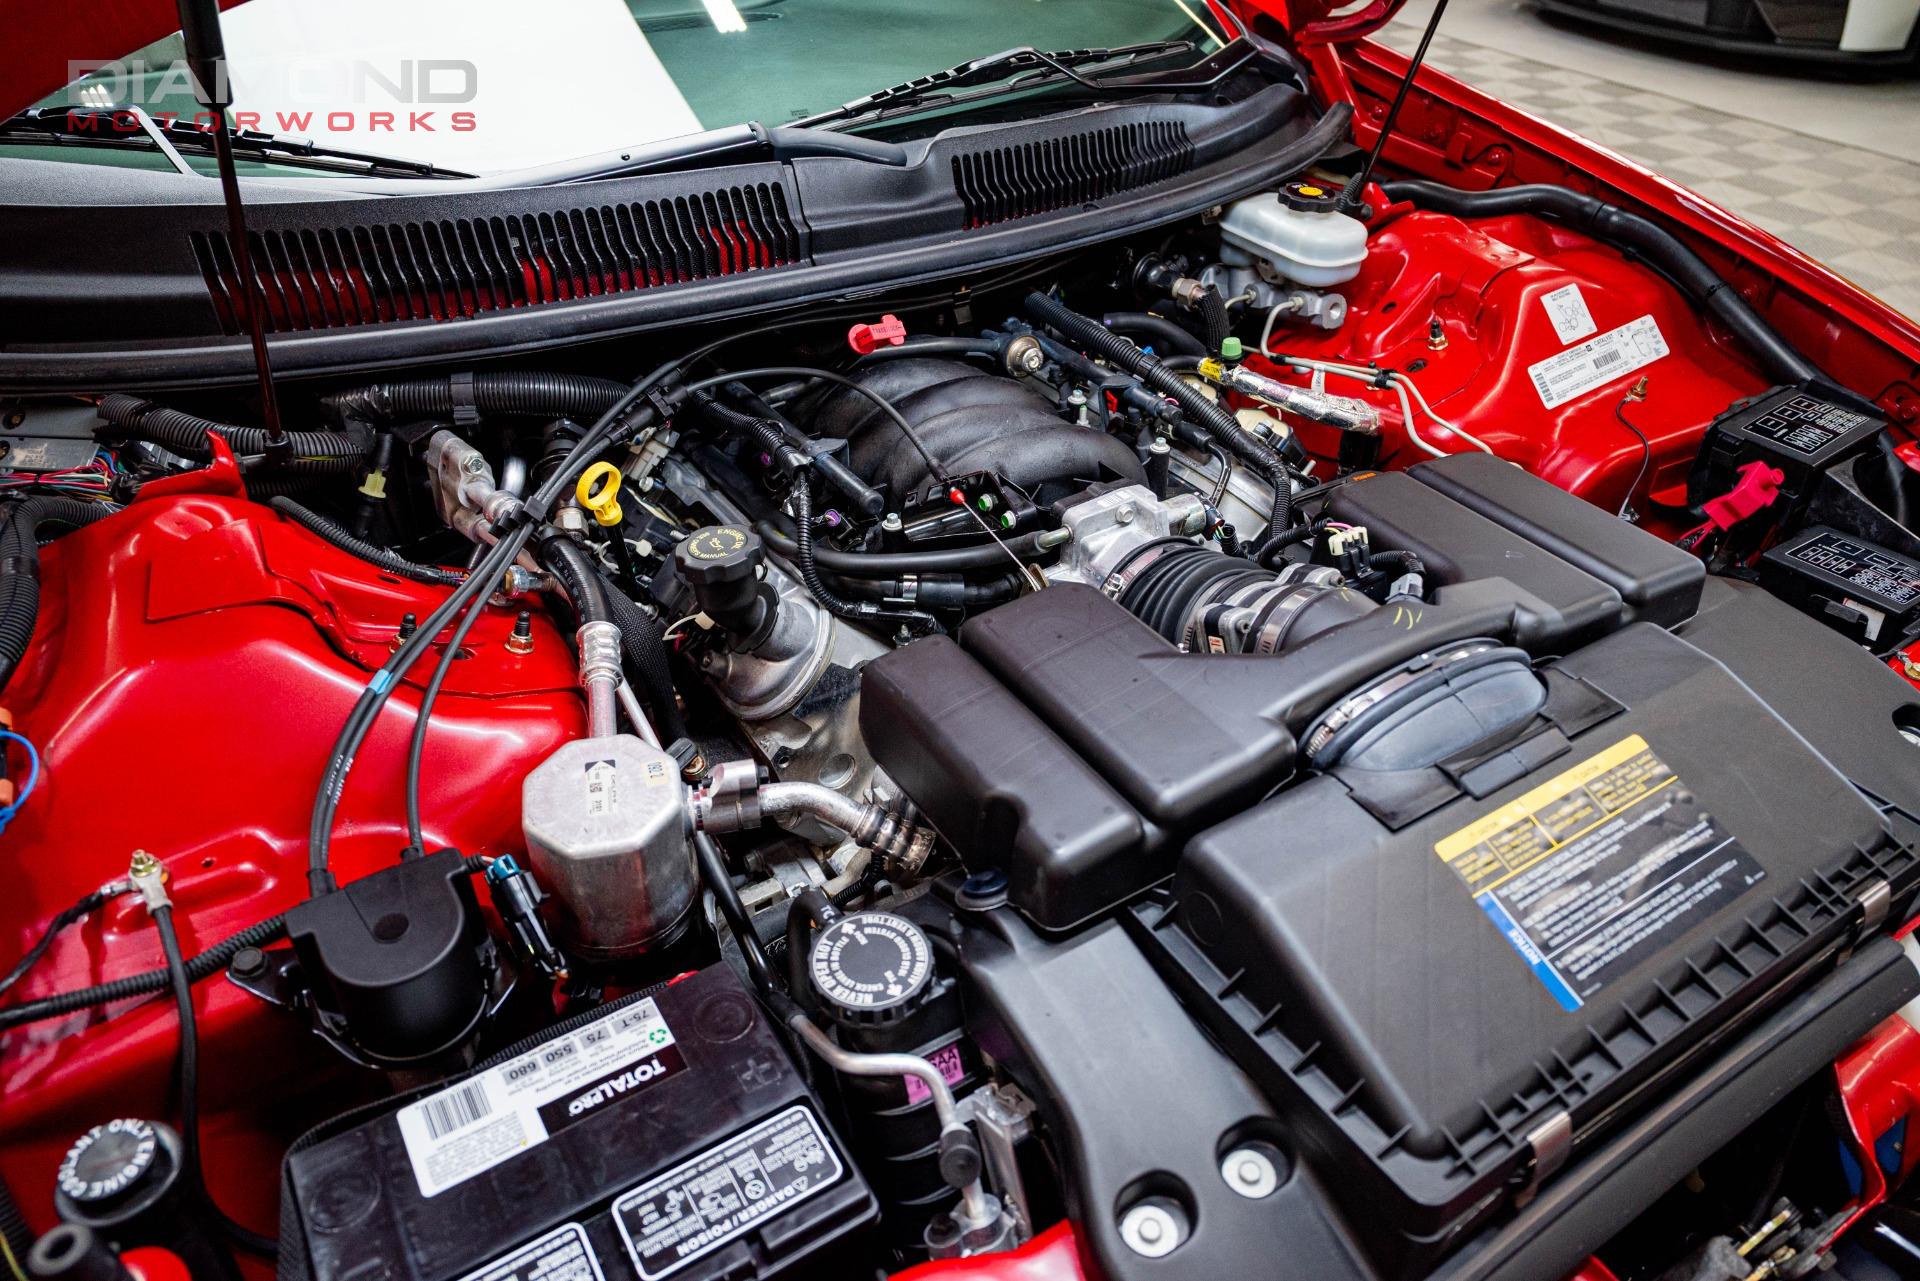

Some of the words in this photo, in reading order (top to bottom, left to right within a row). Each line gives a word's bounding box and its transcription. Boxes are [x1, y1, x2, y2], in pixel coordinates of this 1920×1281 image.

[699, 551, 728, 559] MANUAL
[815, 937, 833, 959] HOT
[829, 935, 850, 961] BOTTLE
[815, 961, 836, 988] OPEN
[833, 969, 856, 987] LEVEL
[832, 984, 873, 1004] NEVER
[853, 982, 884, 992] CHECK
[618, 1007, 650, 1030] 75-T
[584, 1028, 605, 1046] 75
[543, 1042, 574, 1064] 550
[507, 1059, 538, 1082] 680
[566, 1058, 667, 1116] TOTALPRO
[107, 1117, 154, 1139] ONLY
[57, 1124, 103, 1197] COOLANT
[88, 1140, 155, 1198] ENGINE
[674, 1183, 796, 1258] DANGER/POISON
